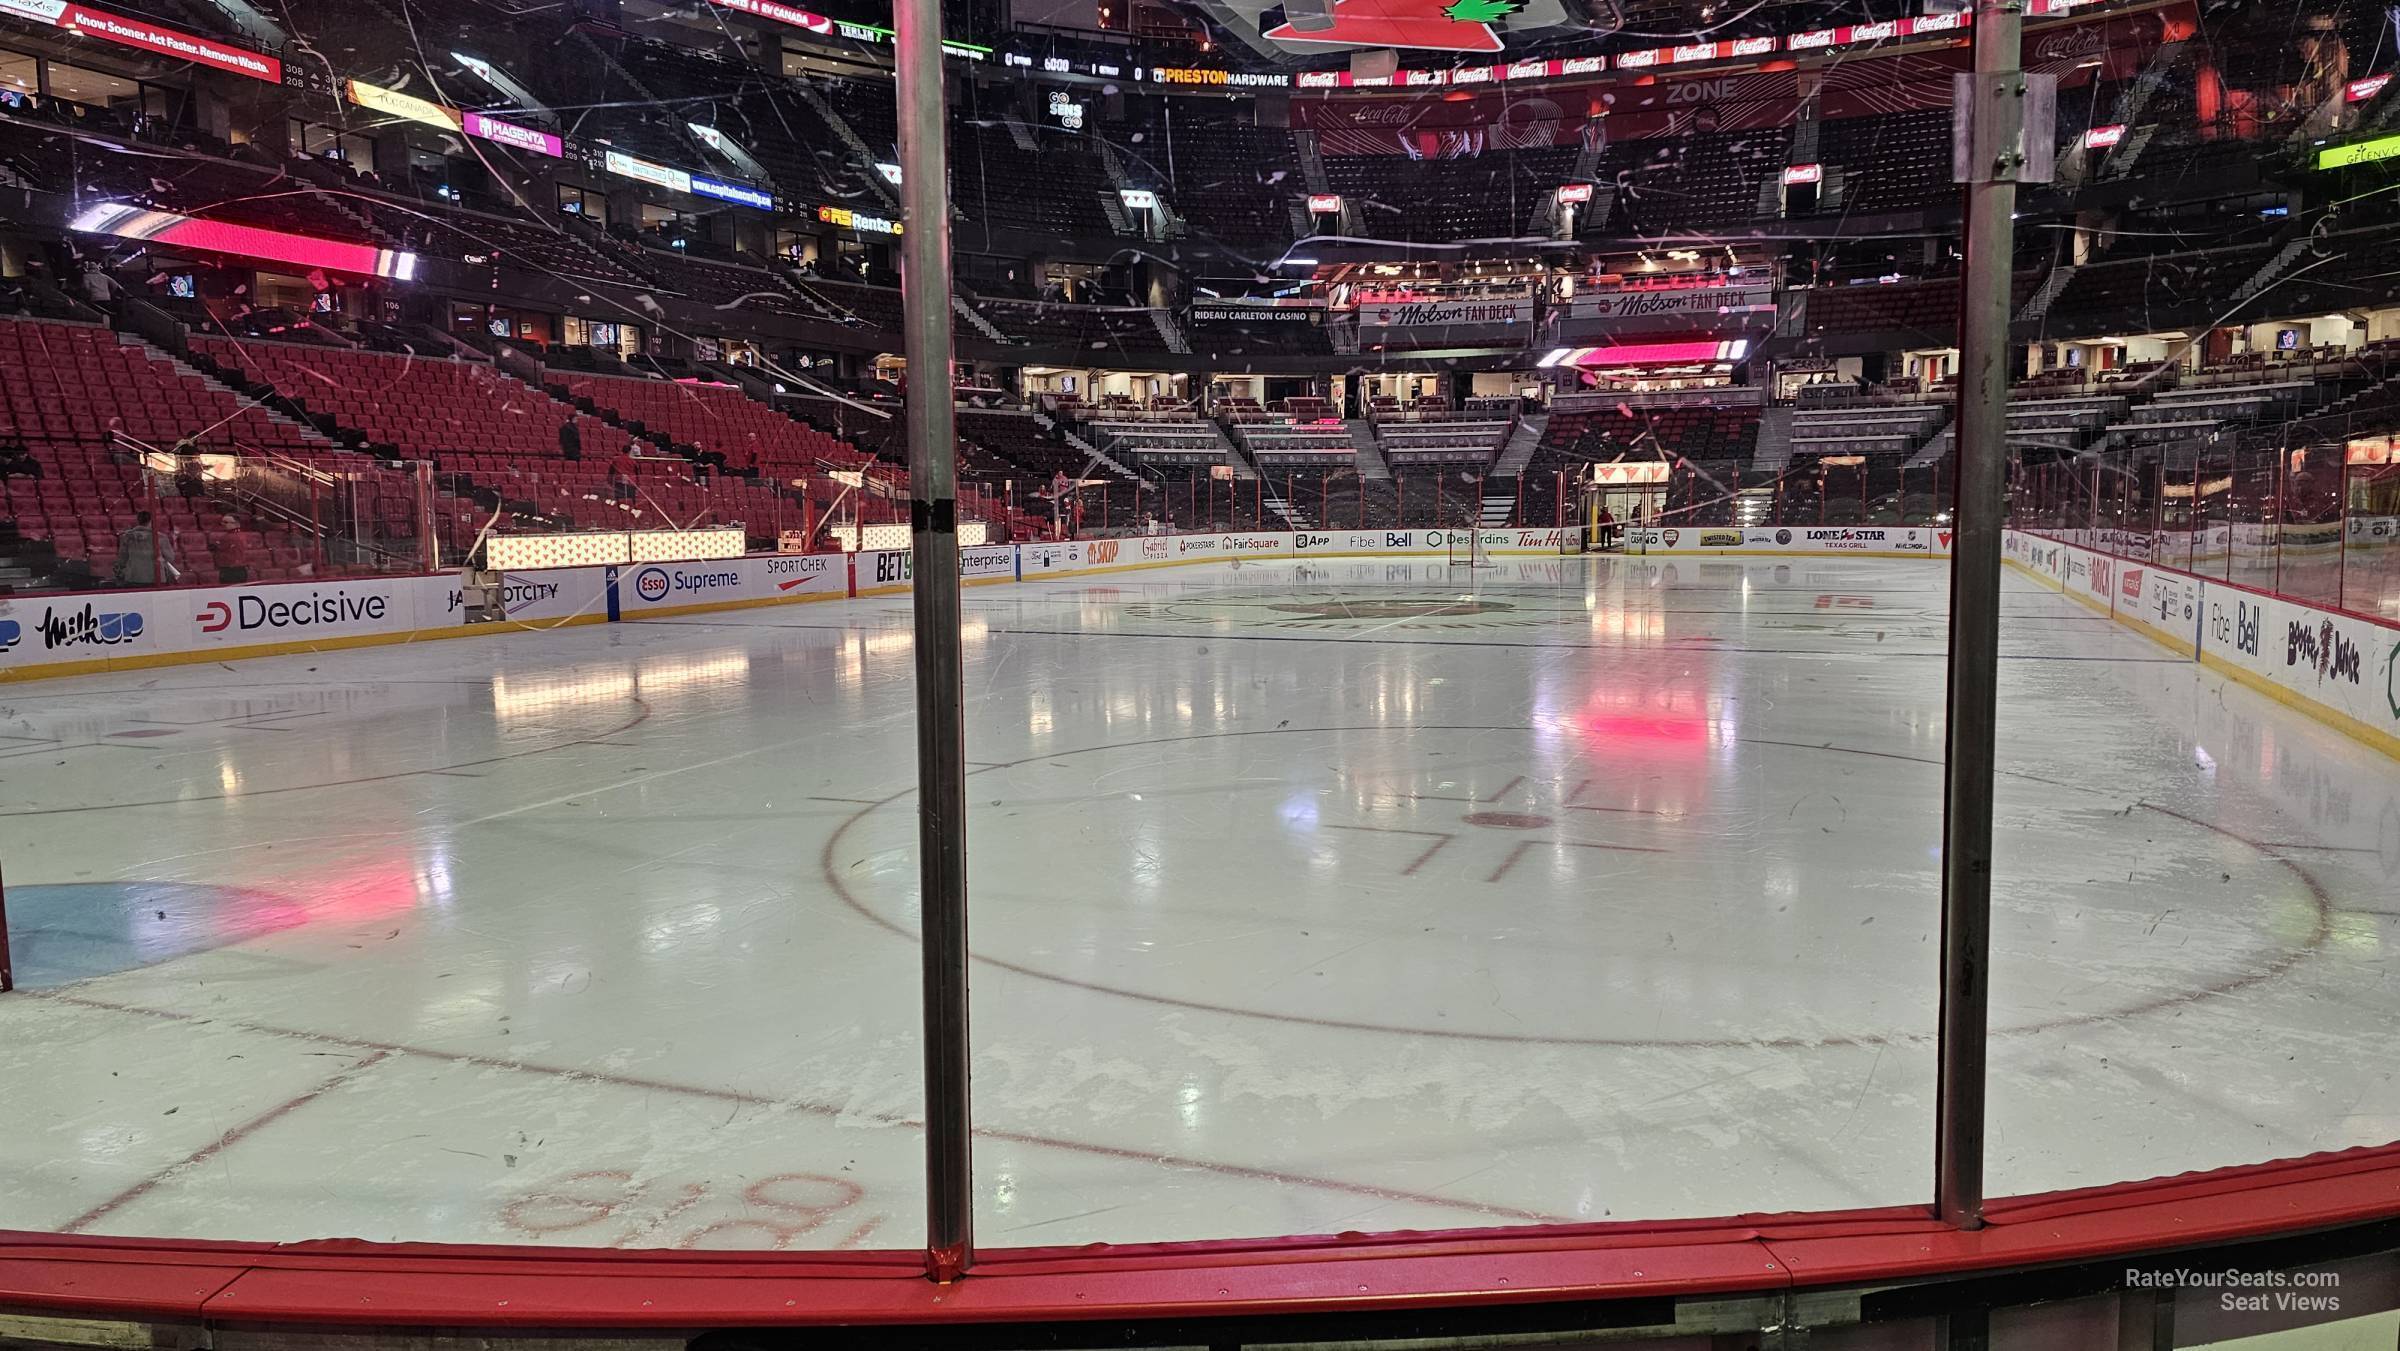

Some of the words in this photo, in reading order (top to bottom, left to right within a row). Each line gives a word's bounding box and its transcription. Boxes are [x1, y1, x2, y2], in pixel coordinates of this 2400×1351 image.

[773, 7, 809, 26] CANADA
[75, 13, 107, 31] Know
[107, 20, 149, 42] Sooner.
[149, 33, 167, 47] Act
[167, 38, 199, 55] Faster.
[199, 46, 239, 66] Remove
[238, 55, 270, 74] Waste.
[286, 64, 304, 76] 308
[1166, 68, 1228, 85] PRESTON
[1228, 74, 1288, 87] HARDWARE
[286, 76, 304, 88] 208
[1666, 79, 1738, 104] ZONE
[1049, 103, 1083, 116] SENS
[492, 122, 547, 146] MAGENTA
[564, 141, 577, 151] 309
[593, 149, 604, 158] 310
[564, 151, 578, 160] 209
[594, 160, 605, 168] 210
[385, 301, 400, 310] 106
[1614, 292, 1687, 316] Molson
[1690, 294, 1713, 310] FAN
[1715, 290, 1747, 308] DECK
[1194, 311, 1227, 320] RIDEAU
[1228, 311, 1274, 321] CARLETON
[1274, 312, 1307, 321] CASINO
[1394, 303, 1463, 325] Molson
[1464, 305, 1487, 322] FAN
[1488, 303, 1517, 320] DECK
[1350, 536, 1375, 548] Fibe
[1386, 532, 1412, 547] Bell
[1446, 533, 1509, 545] Desrdins
[1517, 530, 1542, 547] Tim
[1806, 530, 1839, 541] LONE
[1855, 529, 1885, 541] STAR
[1186, 539, 1215, 551] POKERSTARS
[1233, 537, 1279, 551] FairSquare
[1097, 541, 1119, 564] SKIP
[876, 551, 912, 583] BET9
[962, 552, 1010, 570] nterprise
[674, 570, 739, 594] Supreme
[238, 590, 386, 630] Decisive
[2211, 603, 2230, 644] Fibe
[2237, 600, 2261, 657] Bell
[2287, 620, 2320, 671] Booster
[2330, 630, 2361, 685] Juice
